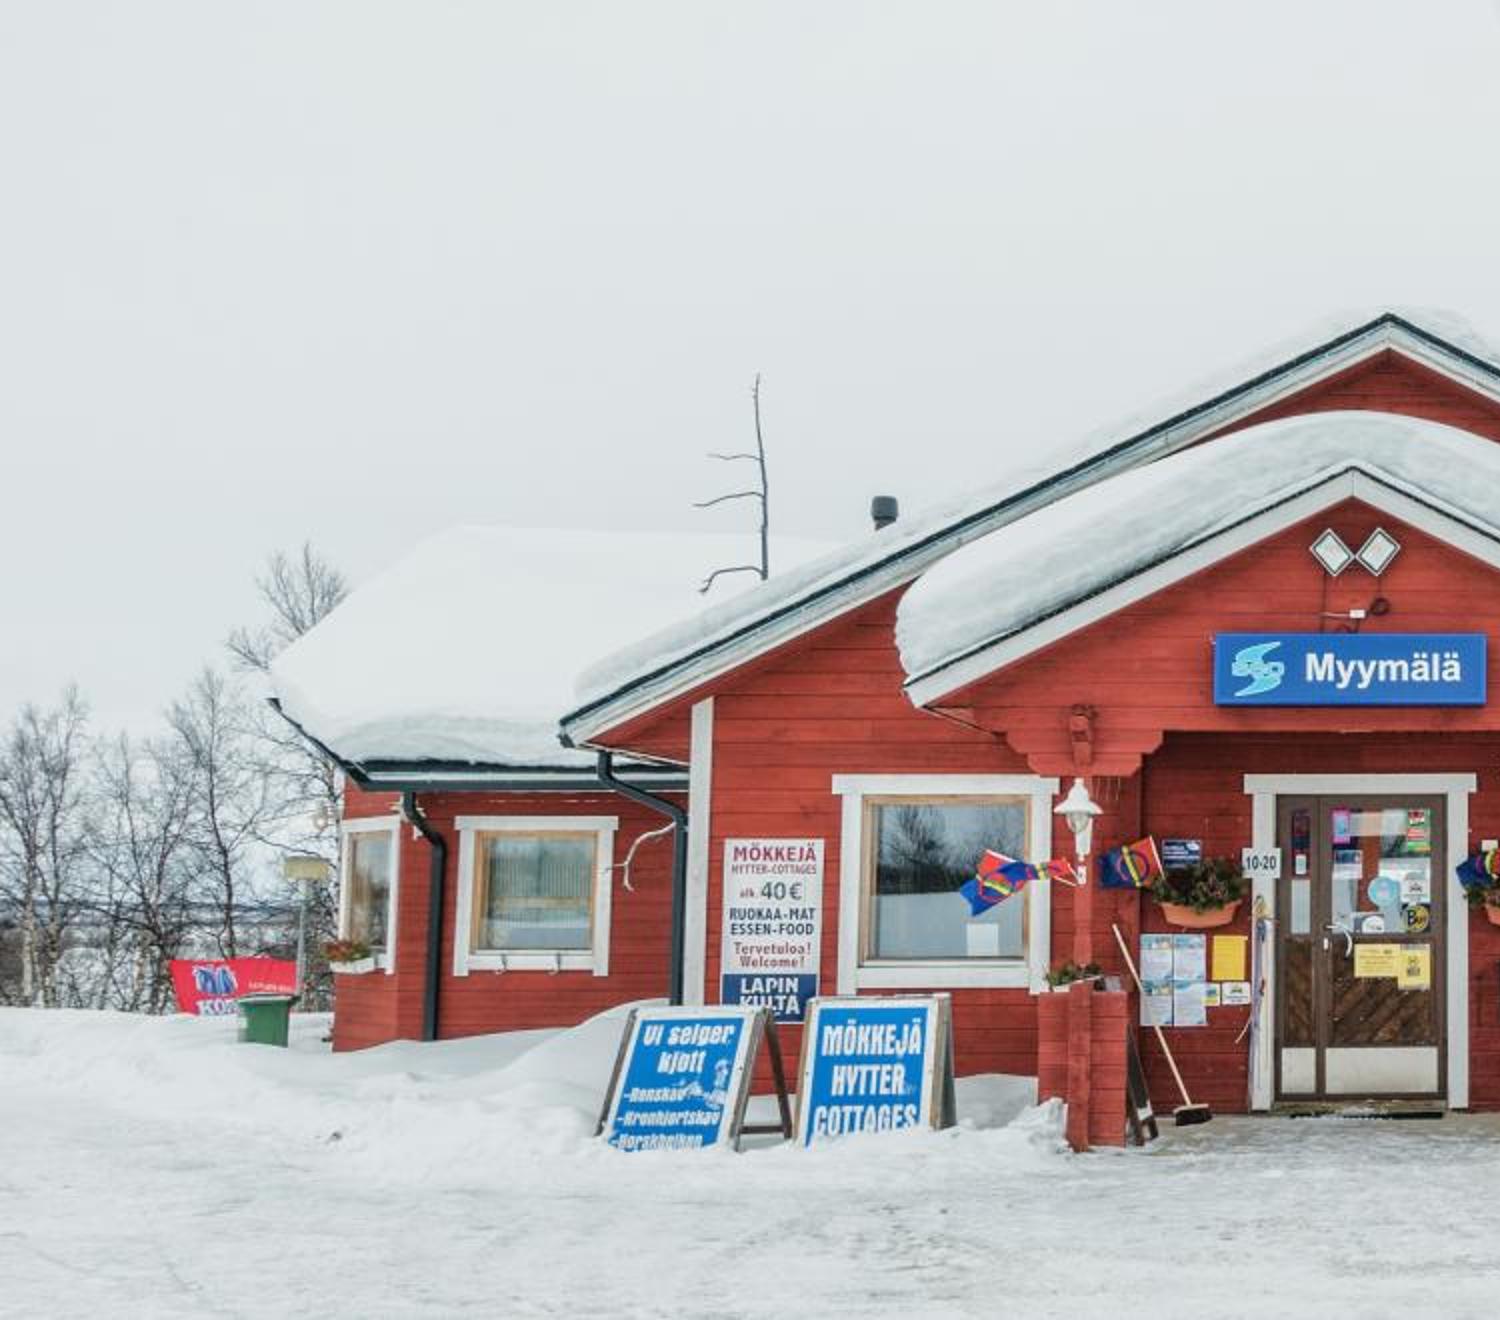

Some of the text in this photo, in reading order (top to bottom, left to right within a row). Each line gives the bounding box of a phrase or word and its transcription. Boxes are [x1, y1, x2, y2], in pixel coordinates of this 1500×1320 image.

[1305, 651, 1461, 689] Myymälä
[733, 842, 816, 861] MÖKKEJÄ
[731, 864, 817, 875] HYTTER-COTTAGES
[1246, 855, 1277, 870] 10-20
[731, 923, 815, 935] ESSEN-FOOD
[740, 955, 805, 968] Welcome!
[741, 978, 799, 993] LAPIN
[667, 1023, 734, 1046] selger
[821, 1018, 922, 1057] MÖKKEJÄ
[831, 1065, 906, 1096] HYTTER
[814, 1104, 917, 1137] COTTAGES
